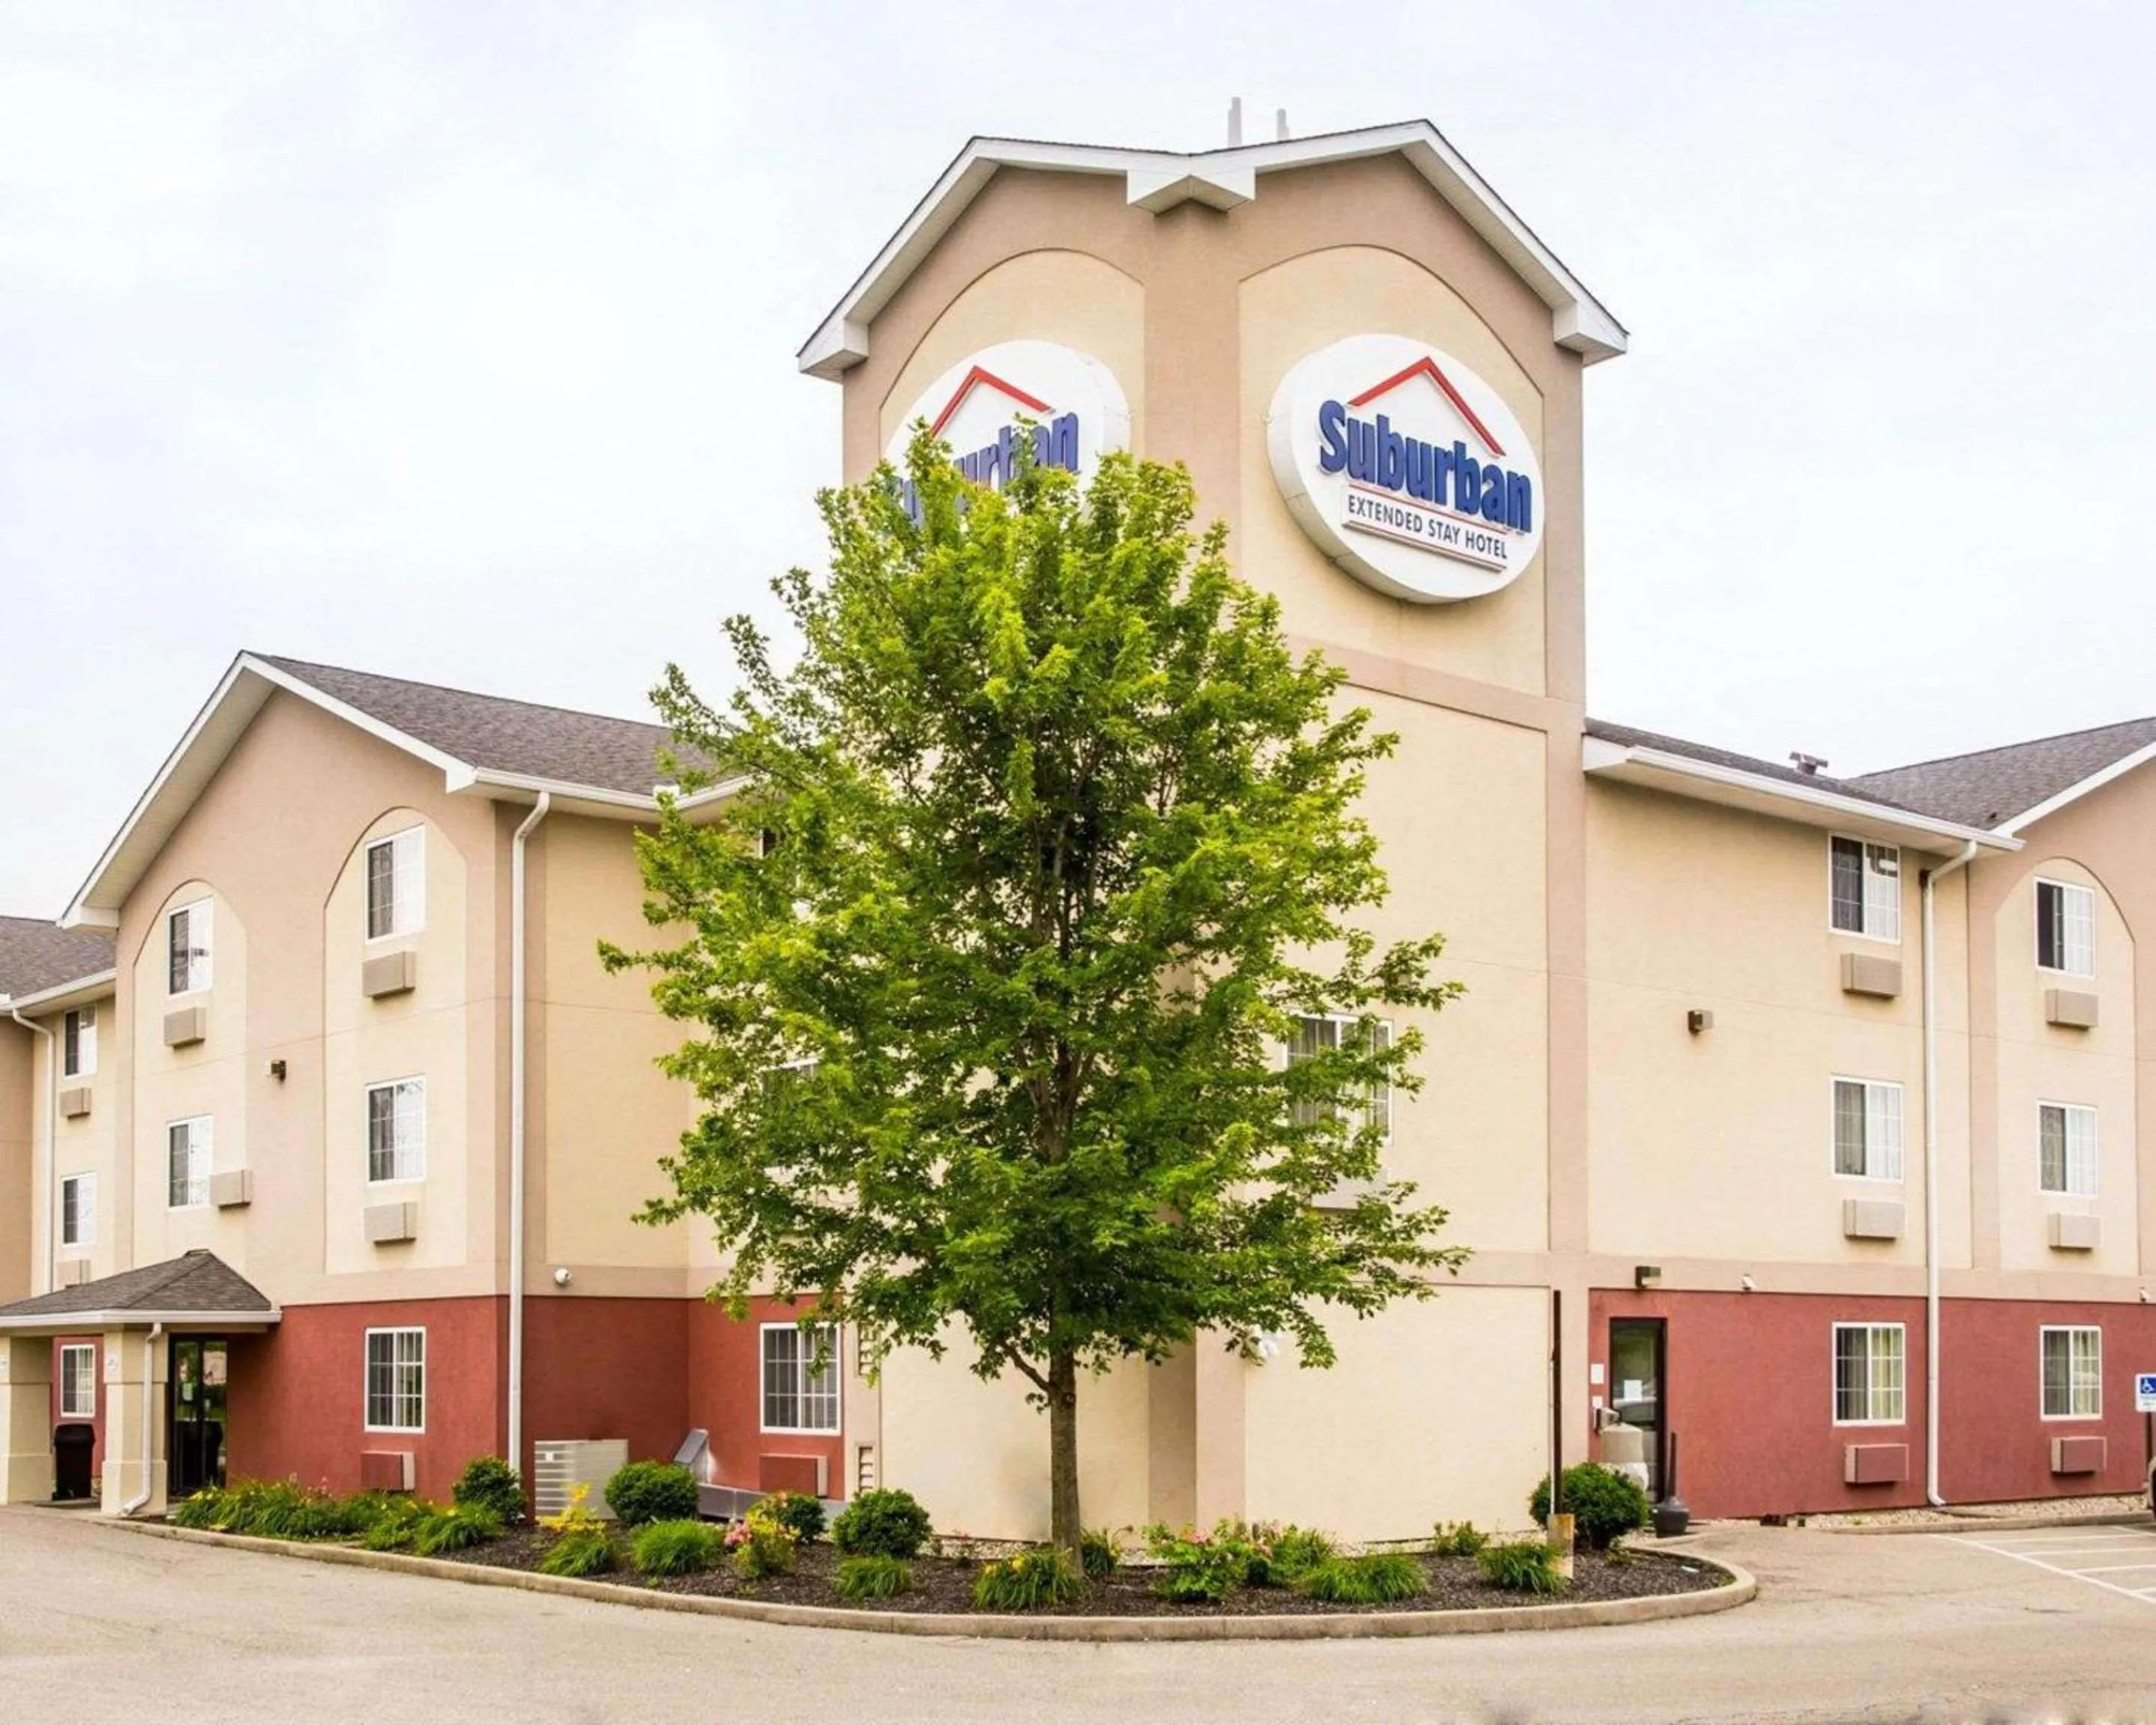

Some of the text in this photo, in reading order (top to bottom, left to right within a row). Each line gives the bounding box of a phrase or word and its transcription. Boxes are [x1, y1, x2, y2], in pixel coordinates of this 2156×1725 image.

[1319, 400, 1531, 532] Suburban
[1348, 494, 1507, 559] EXTENDED STAY HOTEL
